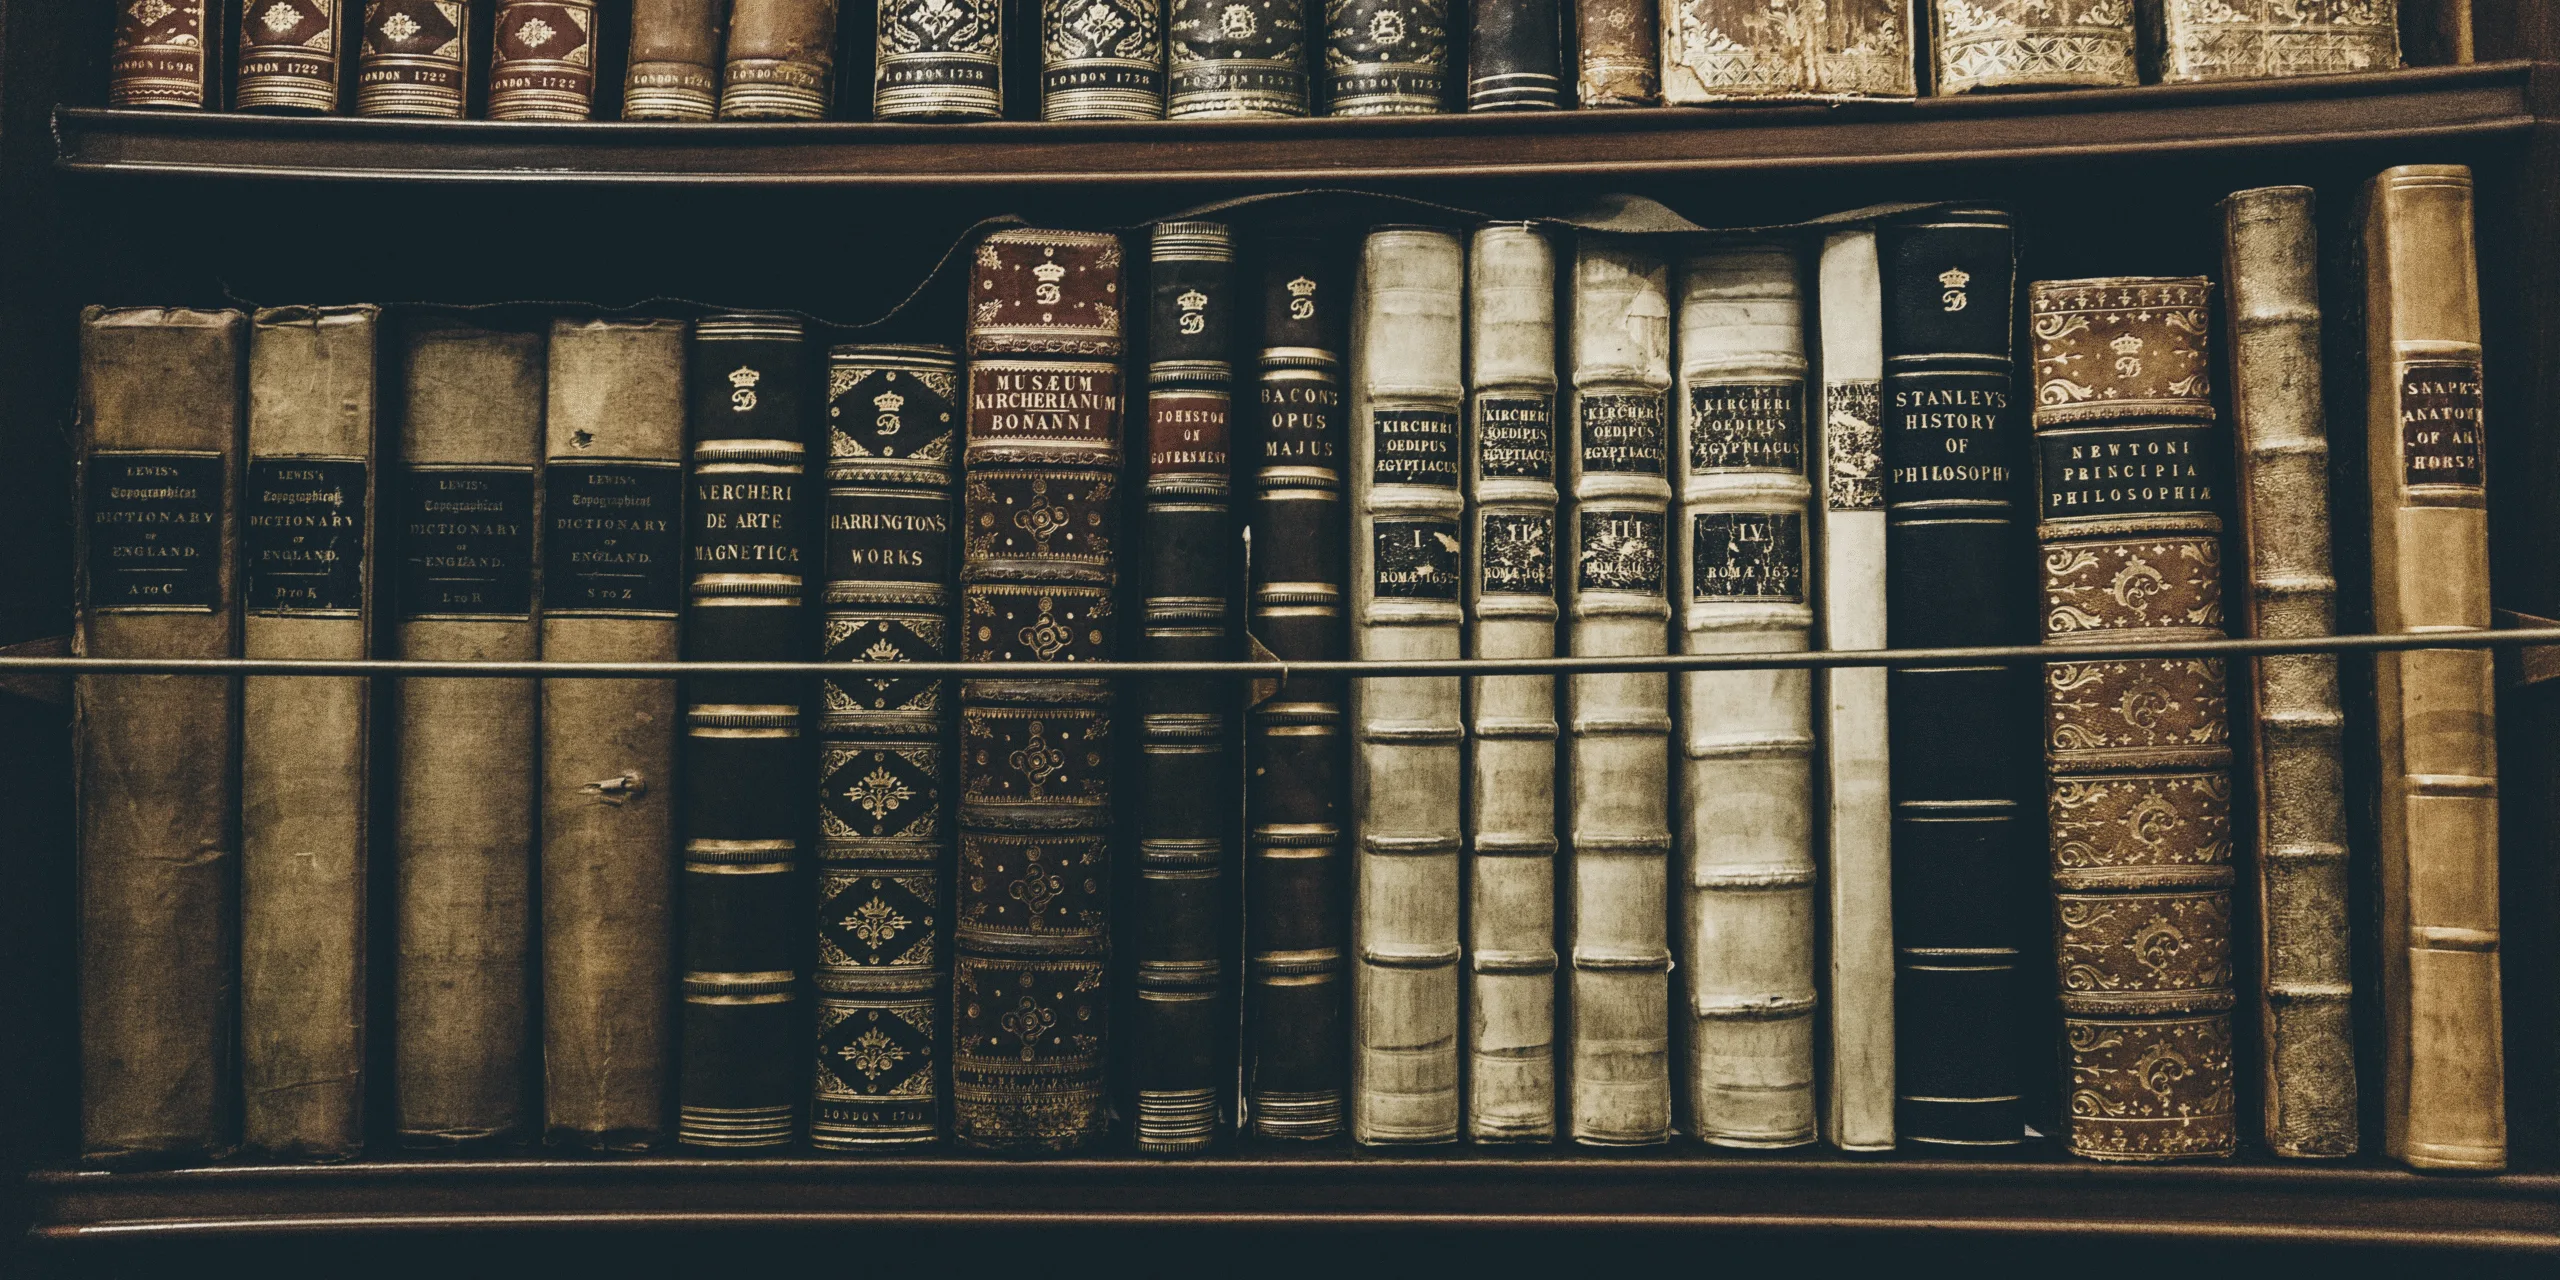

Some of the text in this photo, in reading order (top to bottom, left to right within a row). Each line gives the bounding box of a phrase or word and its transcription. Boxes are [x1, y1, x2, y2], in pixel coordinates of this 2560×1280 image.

[160, 60, 194, 73] 1698
[288, 63, 319, 75] 1722
[415, 71, 447, 82] 1722
[634, 75, 679, 84] LONDON
[733, 69, 779, 80] LONDON
[886, 69, 984, 82] LONDON 1738
[1051, 72, 1150, 86] LONDON 1738
[1183, 74, 1248, 87] LONDON
[542, 77, 576, 89] 1722
[1337, 79, 1442, 91] LONDON 1753
[996, 374, 1093, 392] MUSÆUM
[975, 392, 1116, 411] KIRCHERIANUM
[1704, 398, 1791, 411] KIRCHERI
[1896, 390, 2007, 408] STANLEY'S
[991, 413, 1091, 430] BONANNI
[1157, 410, 1224, 424] JOHNSTON
[1272, 413, 1326, 429] OPUS
[1486, 409, 1549, 422] KIRCHERI
[1906, 414, 1996, 430] HISTORY
[1383, 420, 1452, 434] KIRCHERI
[1594, 425, 1654, 438] OEDIPUS
[1712, 419, 1787, 432] OEDIPUS
[1184, 429, 1200, 441] ON
[1492, 426, 1547, 440] OEDIPUS
[2417, 431, 2473, 444] OF AN
[1266, 441, 1333, 456] MAJUS
[1387, 439, 1447, 453] OEDIPUS
[1945, 438, 1969, 453] OF
[2072, 441, 2189, 459] NEWTONI
[1151, 450, 1226, 464] GOVERNMENT
[2413, 456, 2475, 470] HORSE
[1375, 459, 1458, 474] ÆGYPTIACUS
[2063, 464, 2198, 482] PRINCIPIA
[1893, 465, 2011, 483] PHILOSOPHY
[111, 487, 197, 501] Topographical
[572, 494, 651, 507] Topographical
[2052, 486, 2212, 507] PHILOSOPHIÆ
[95, 511, 215, 524] DICTIONARY
[251, 515, 353, 527] DICTIONARY
[706, 513, 782, 529] DE ARTE
[831, 513, 946, 532] HARRINGTON'S
[410, 523, 520, 536] DICTIONARY
[557, 518, 667, 532] DICTIONARY
[1612, 520, 1642, 538] III
[1739, 522, 1764, 542] IV
[1509, 523, 1529, 542] II
[695, 544, 799, 562] MAGNETICA
[851, 549, 923, 566] WORKS
[1380, 571, 1454, 583] ROMÆ 1652
[1706, 566, 1799, 578] ROMÆ 1652
[128, 584, 140, 595] A
[163, 583, 173, 594] C
[588, 588, 595, 598] S
[621, 589, 632, 600] Z
[824, 1108, 880, 1121] LONDON
